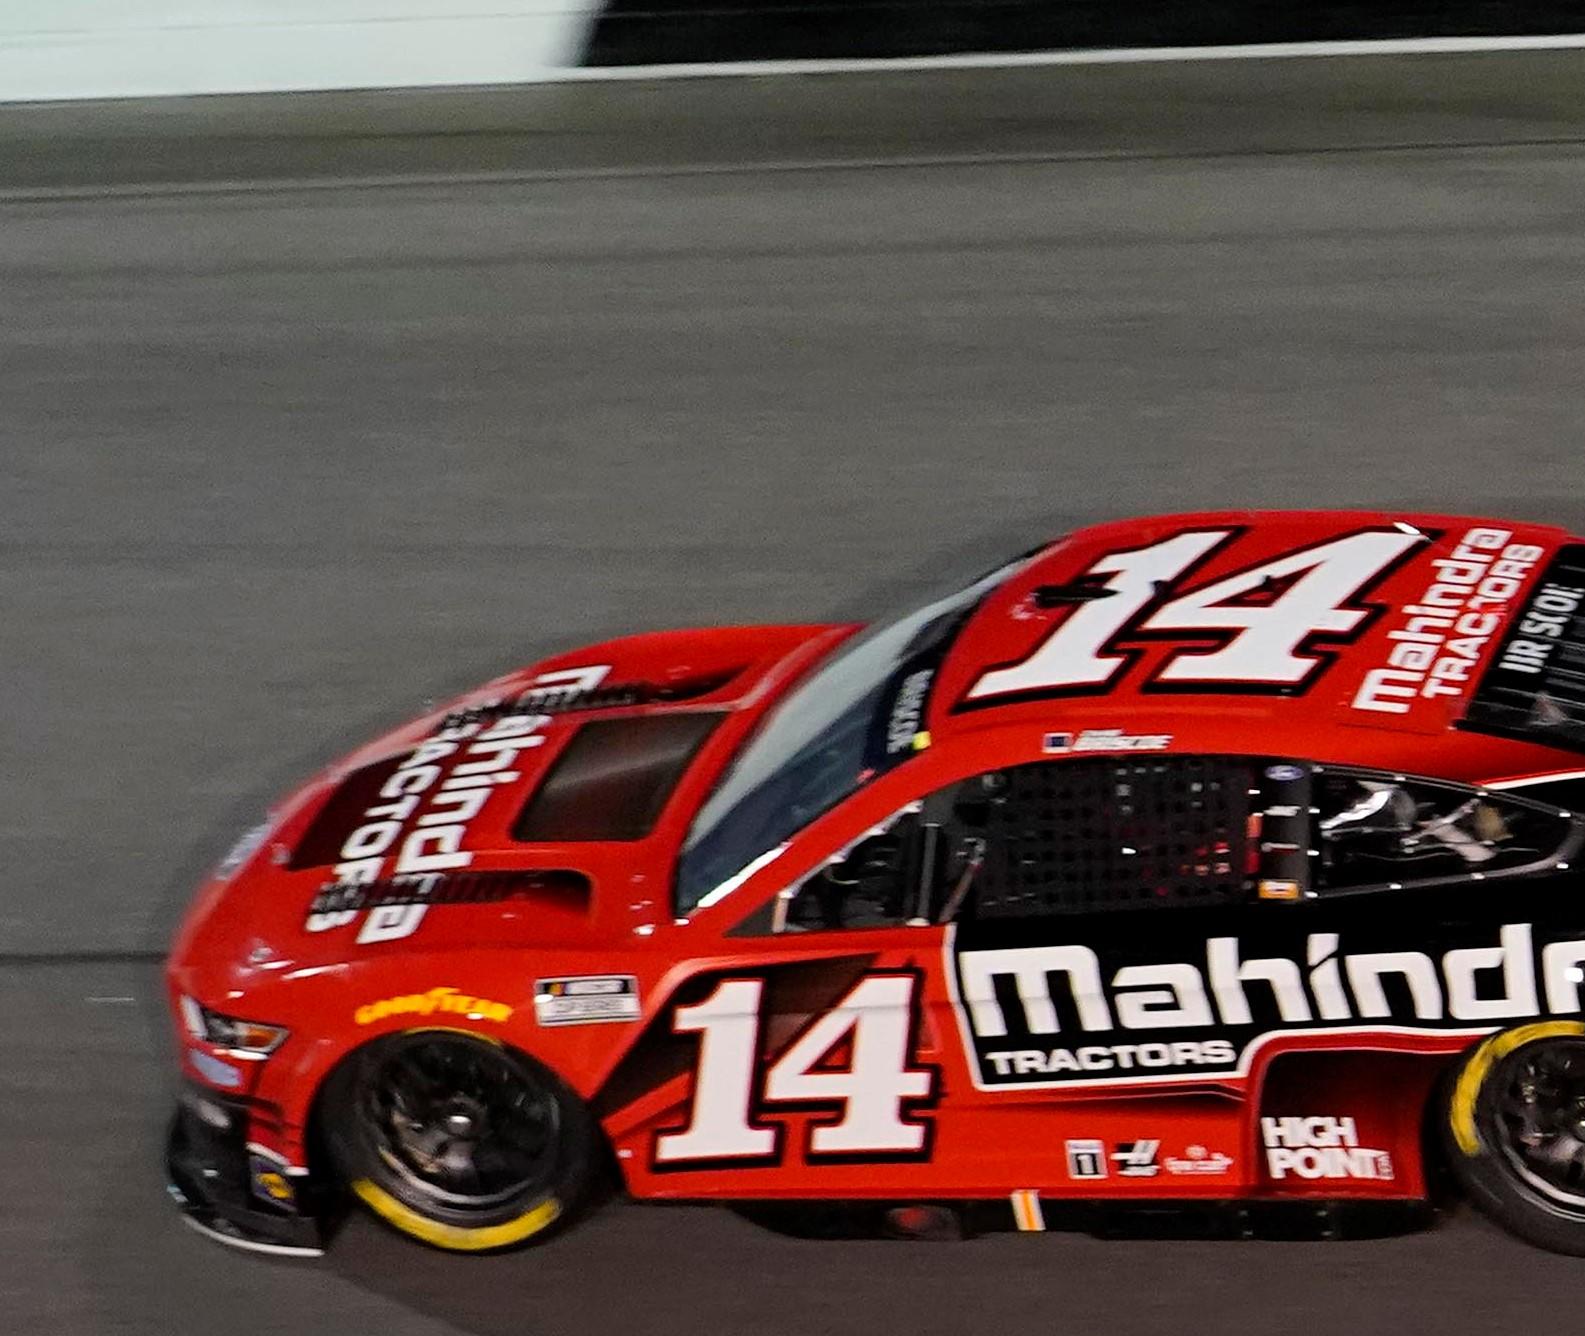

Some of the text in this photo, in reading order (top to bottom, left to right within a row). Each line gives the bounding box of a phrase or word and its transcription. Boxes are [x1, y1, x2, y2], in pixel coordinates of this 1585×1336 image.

[965, 530, 1430, 701] 14
[1351, 527, 1514, 714] Mahindra
[1420, 543, 1545, 698] TRACTORS
[304, 705, 500, 933] RACTORS
[654, 976, 932, 1164] 14
[985, 1039, 1238, 1076] TRACTORS
[1260, 1116, 1360, 1148] HIGH
[1265, 1146, 1390, 1180] POINT
